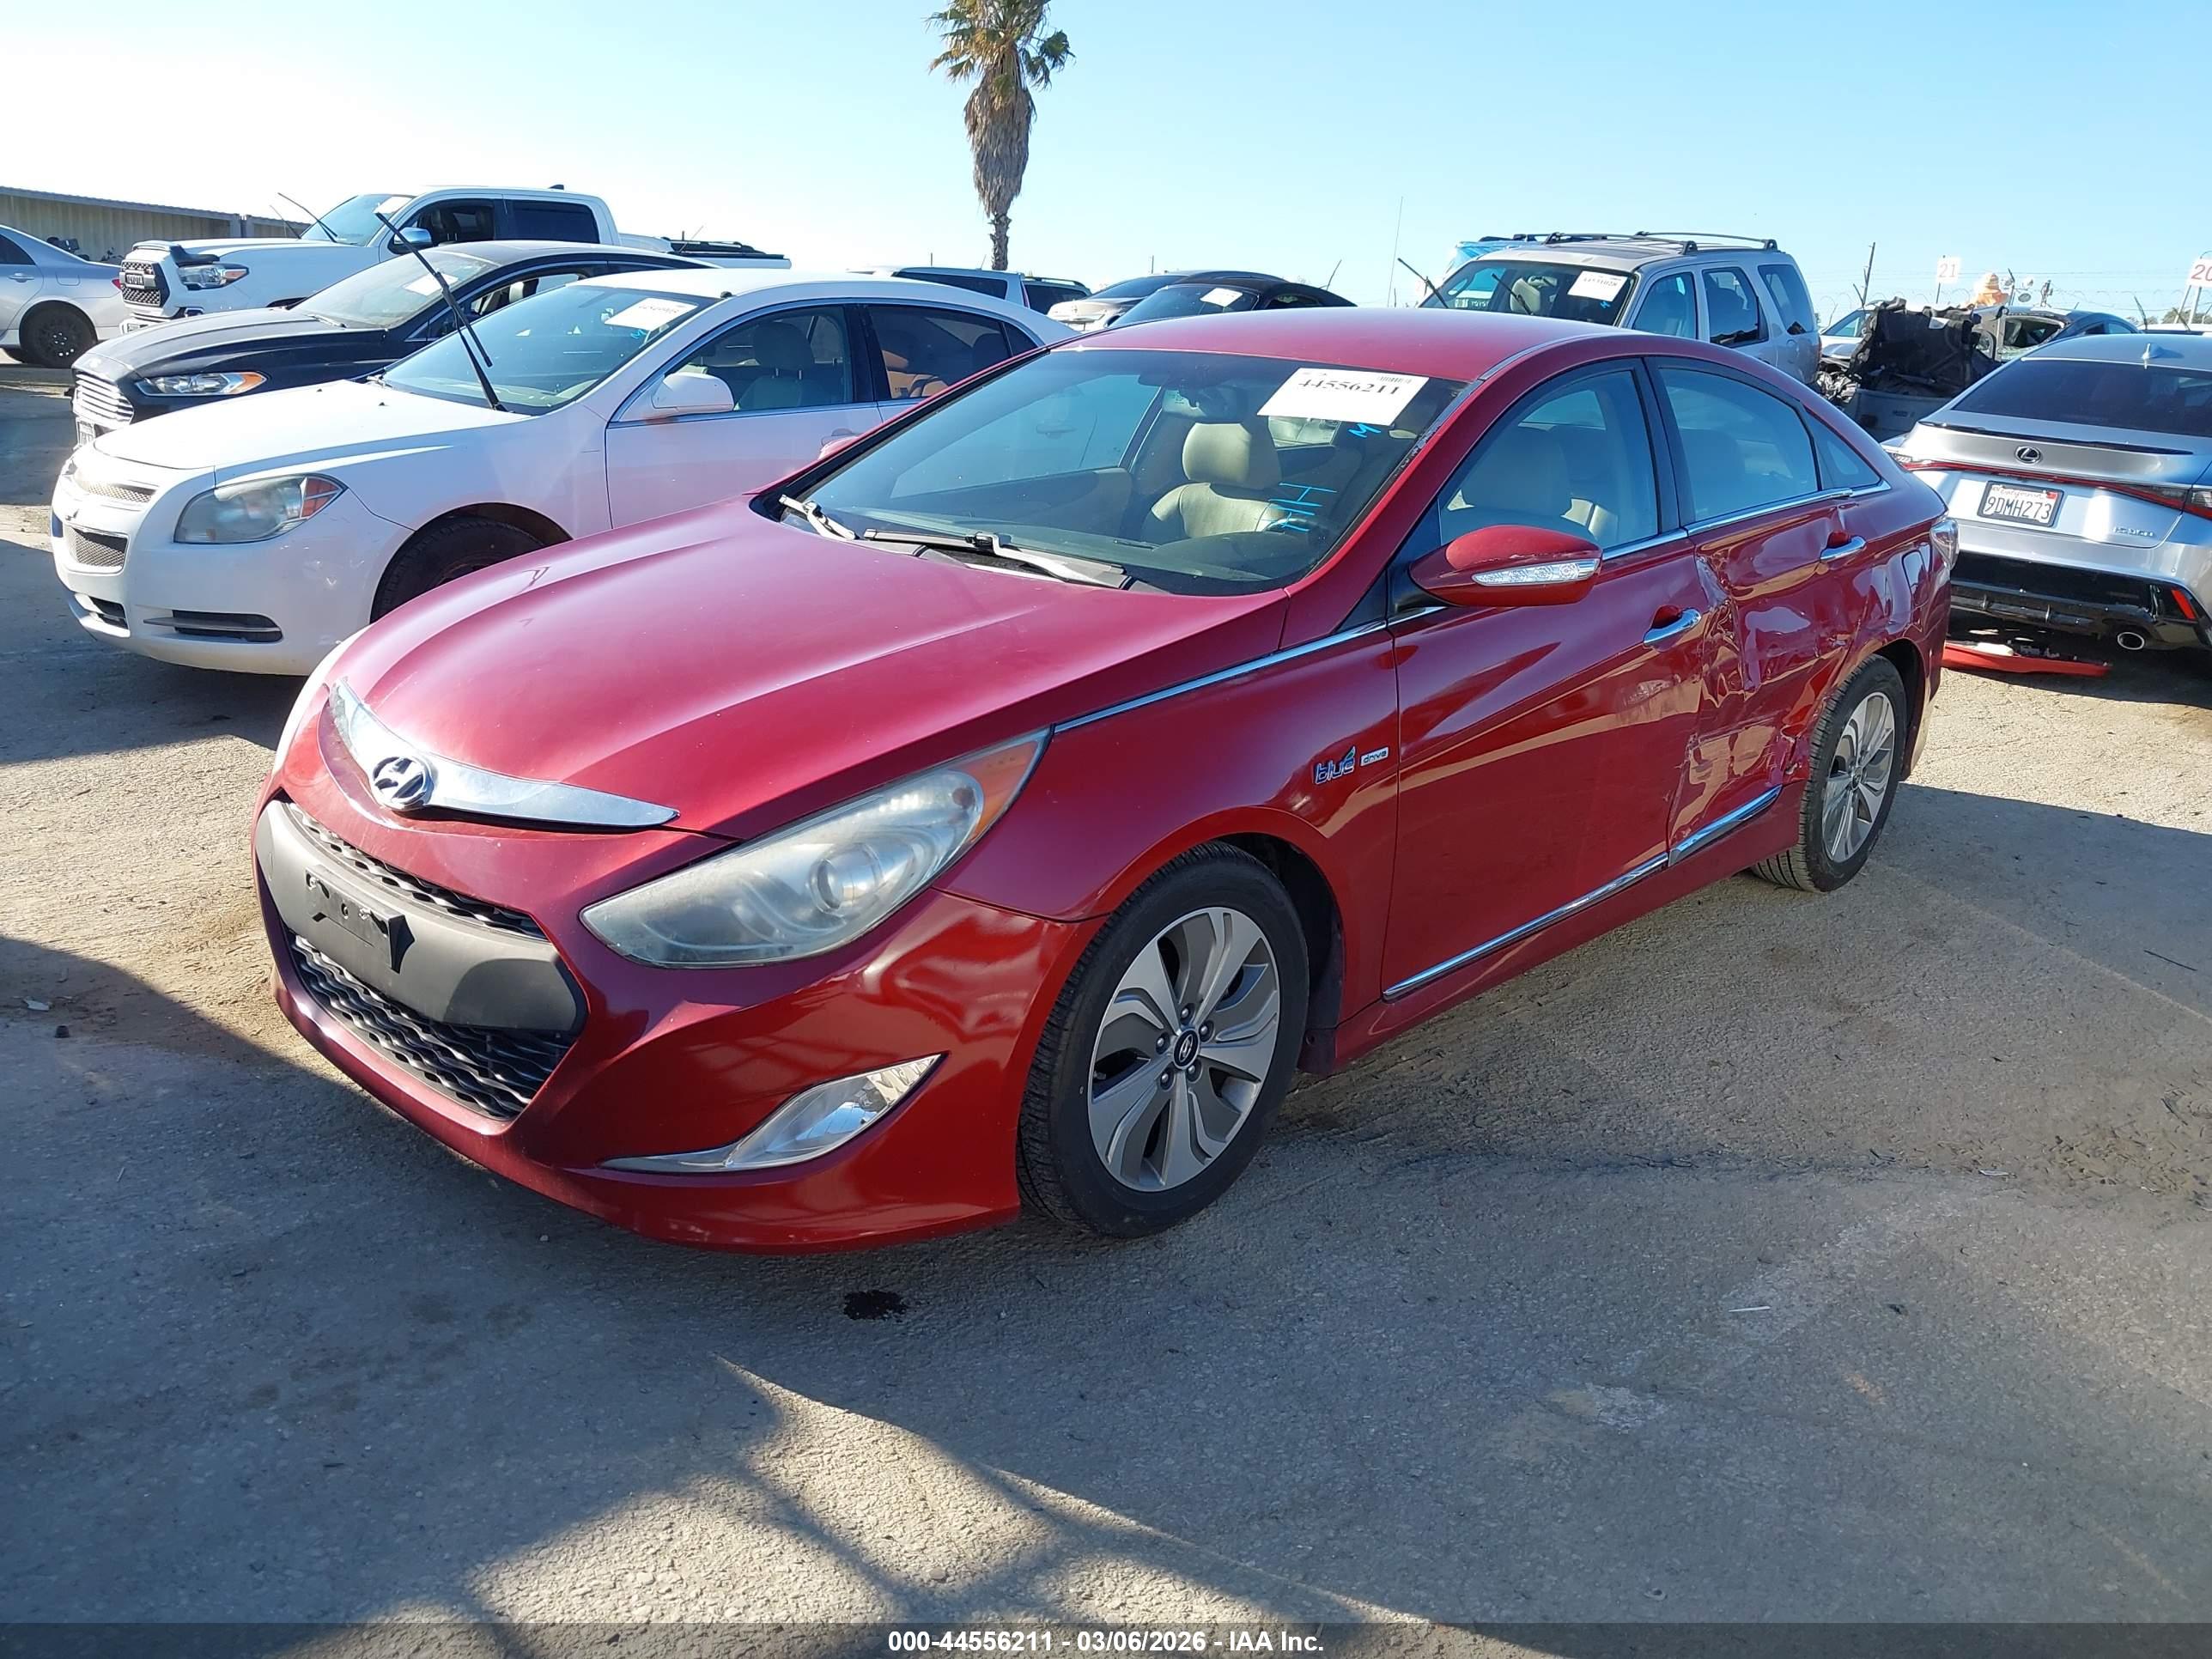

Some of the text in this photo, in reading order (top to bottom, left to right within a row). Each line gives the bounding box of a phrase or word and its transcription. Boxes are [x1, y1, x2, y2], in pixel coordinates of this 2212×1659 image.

[1938, 262, 1956, 278] 21
[1297, 379, 1401, 395] 44556211
[1984, 495, 2052, 520] 9DMH273
[1362, 750, 1388, 764] drive
